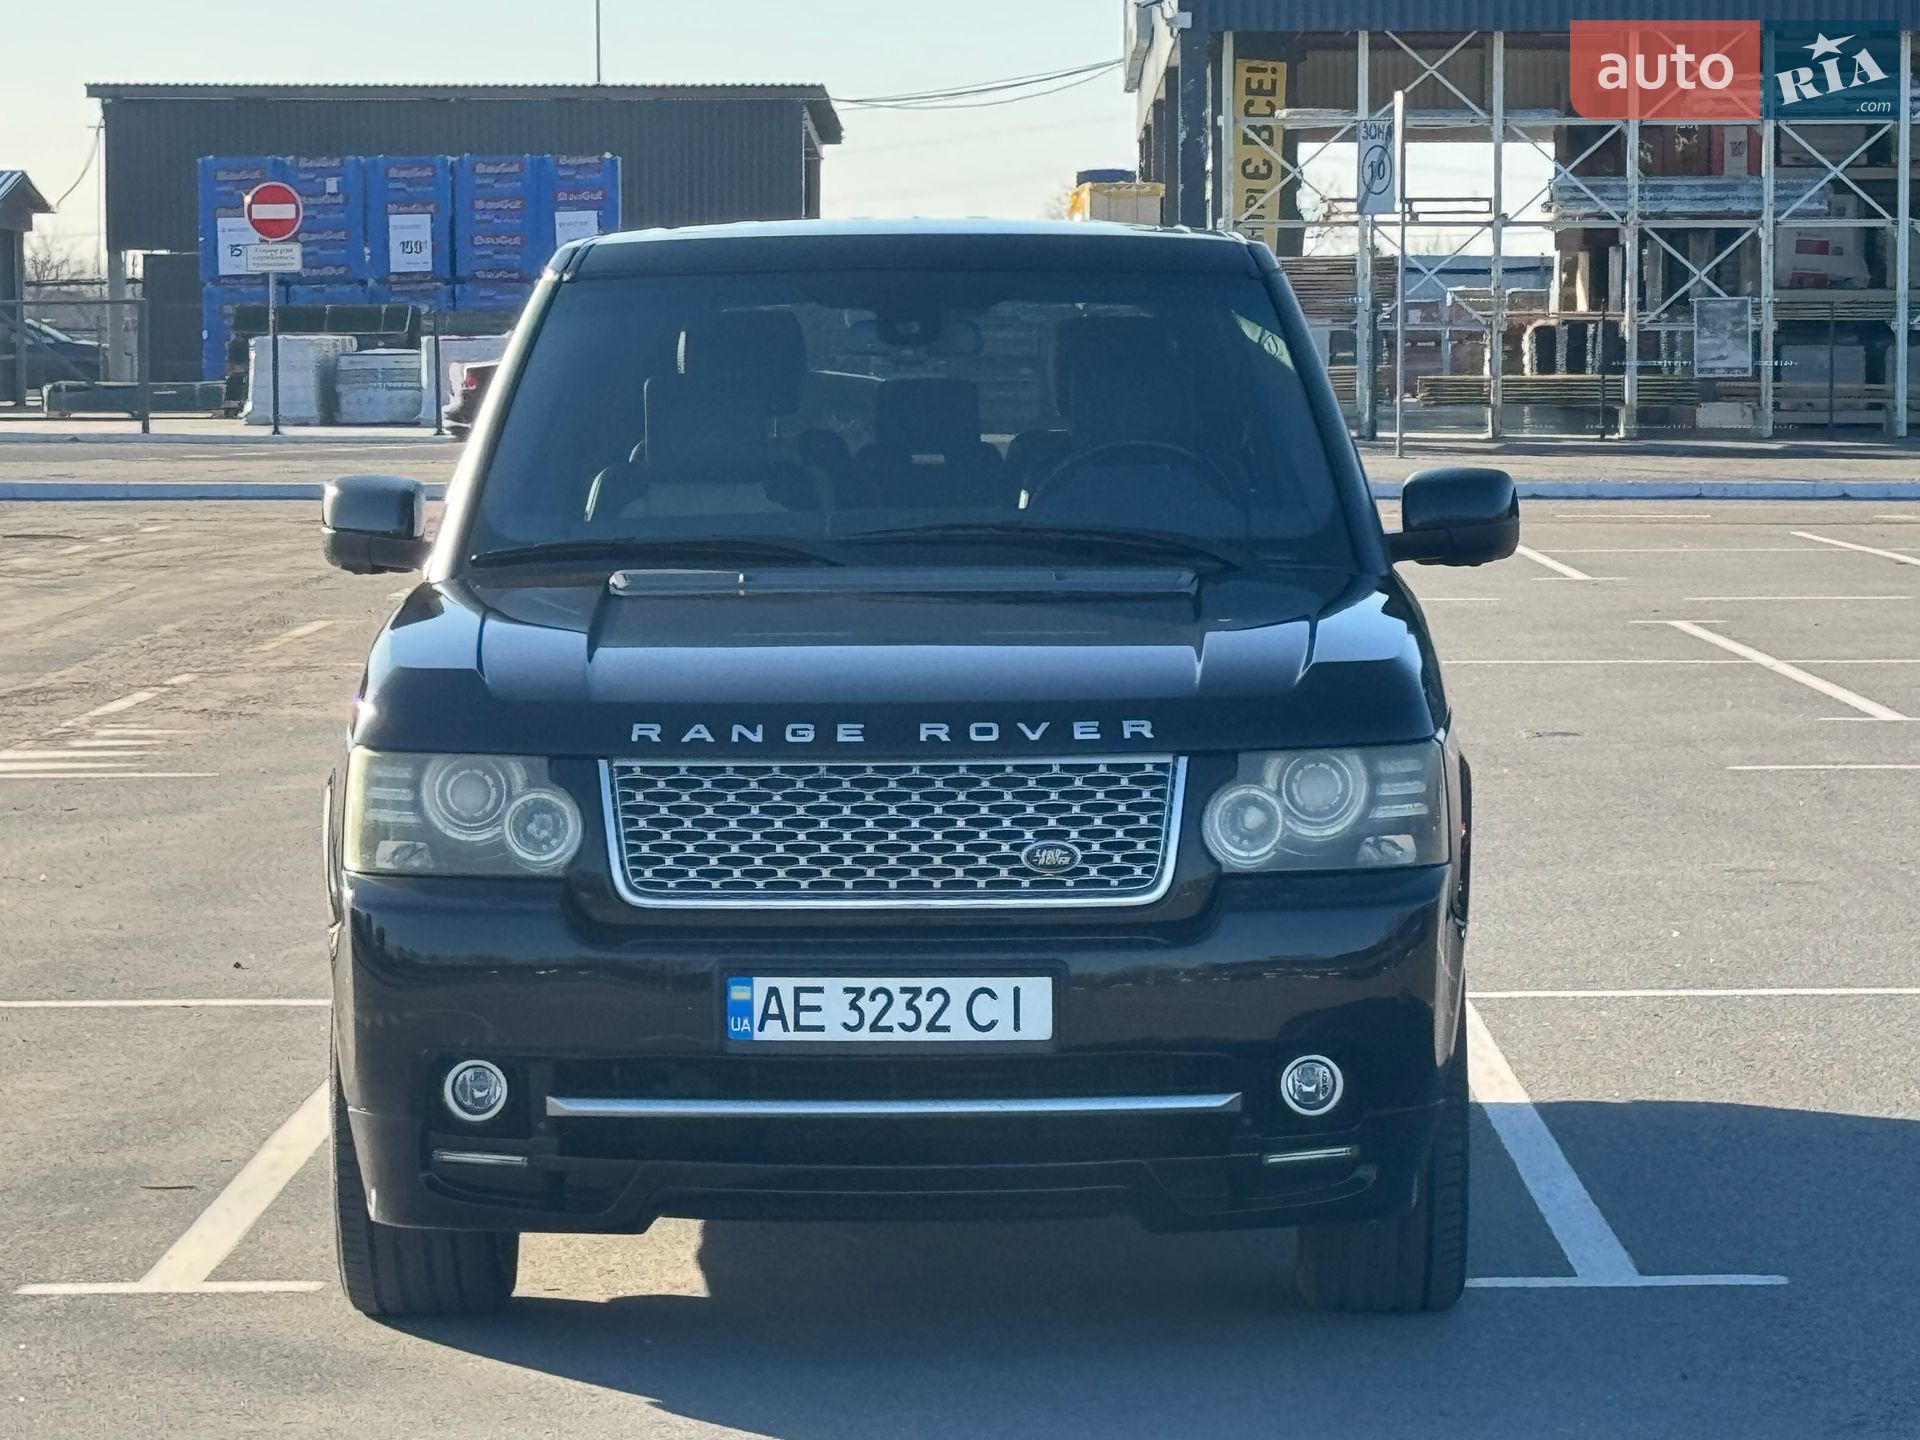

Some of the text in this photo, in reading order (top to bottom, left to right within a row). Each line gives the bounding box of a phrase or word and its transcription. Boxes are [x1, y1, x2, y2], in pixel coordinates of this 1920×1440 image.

[630, 719, 1155, 745] RANGE ROVER
[757, 985, 1022, 1034] AE 3232 CI
[731, 1016, 751, 1032] UA
